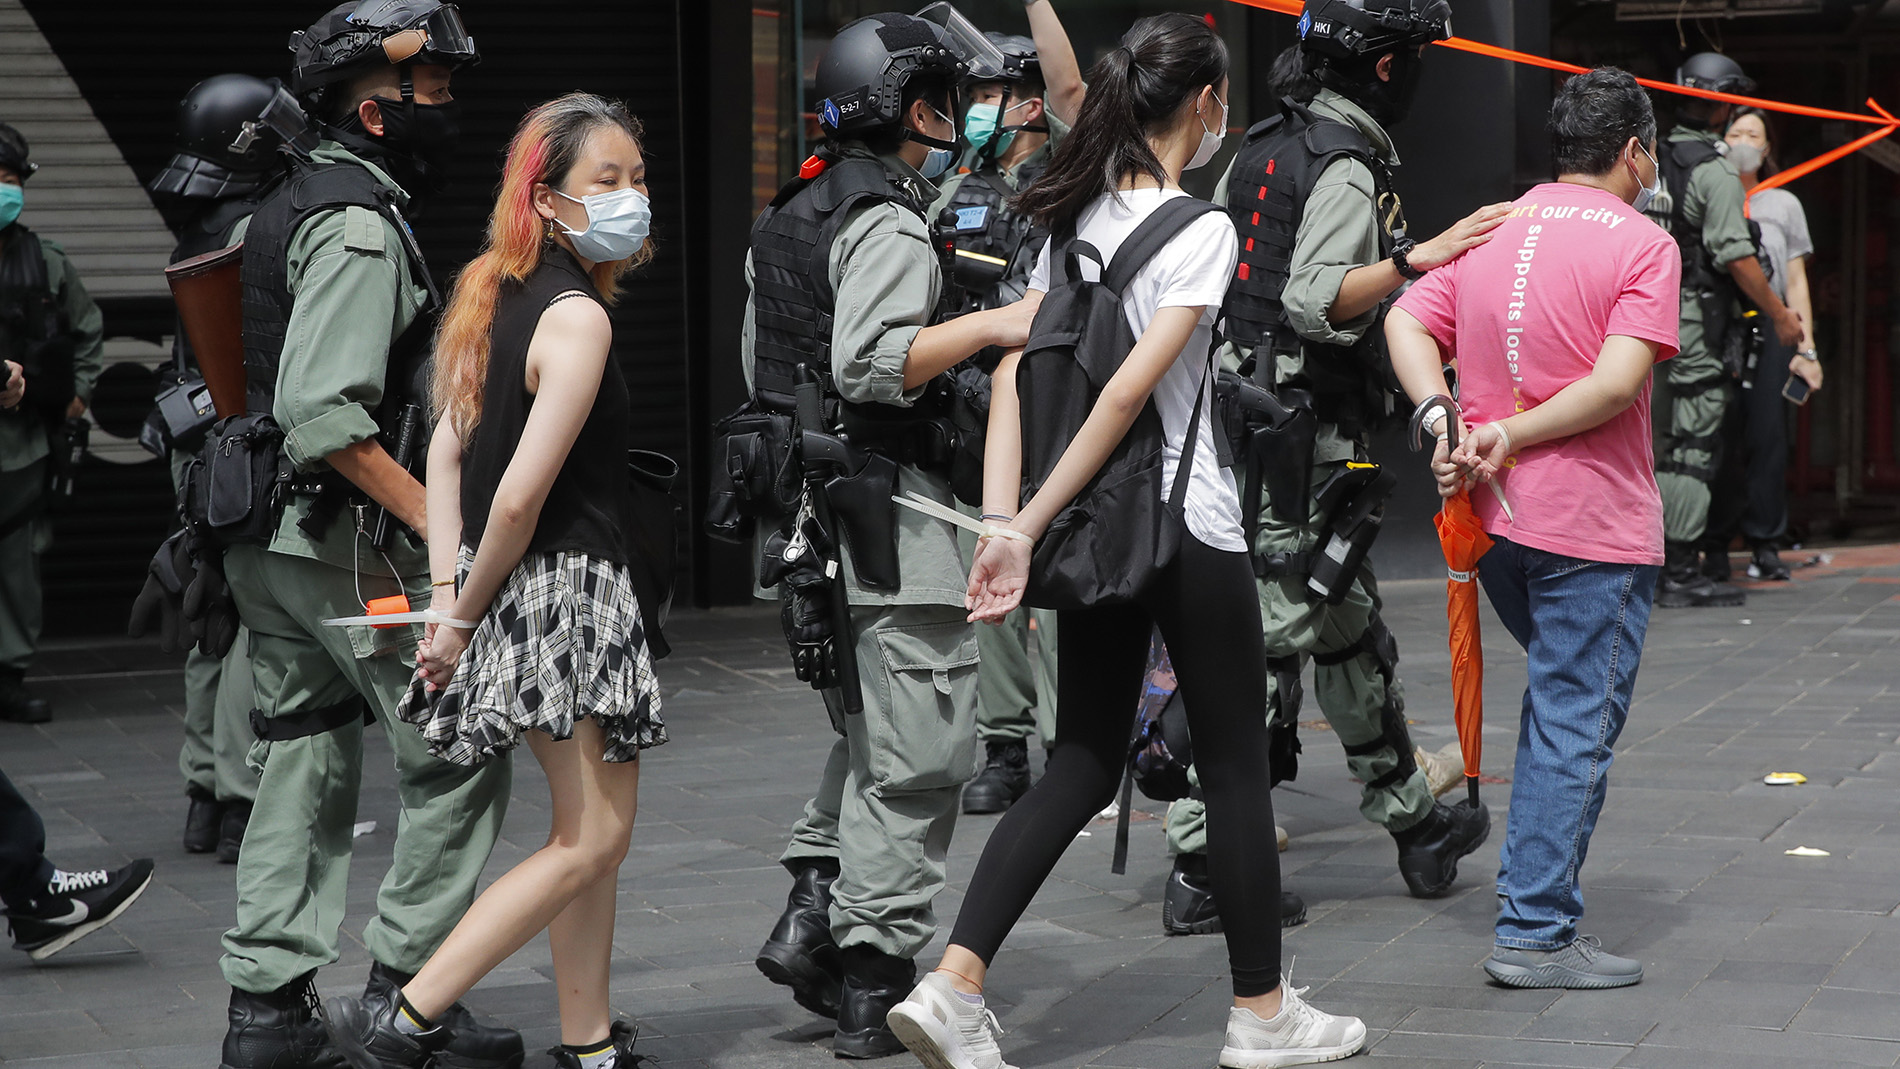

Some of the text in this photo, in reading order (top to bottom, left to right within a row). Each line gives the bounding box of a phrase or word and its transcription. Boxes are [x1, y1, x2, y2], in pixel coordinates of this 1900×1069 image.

[1313, 21, 1331, 34] HKI
[826, 106, 836, 122] 1
[1506, 203, 1627, 229] art our city
[1507, 224, 1543, 322] supports
[1506, 327, 1524, 382] local
